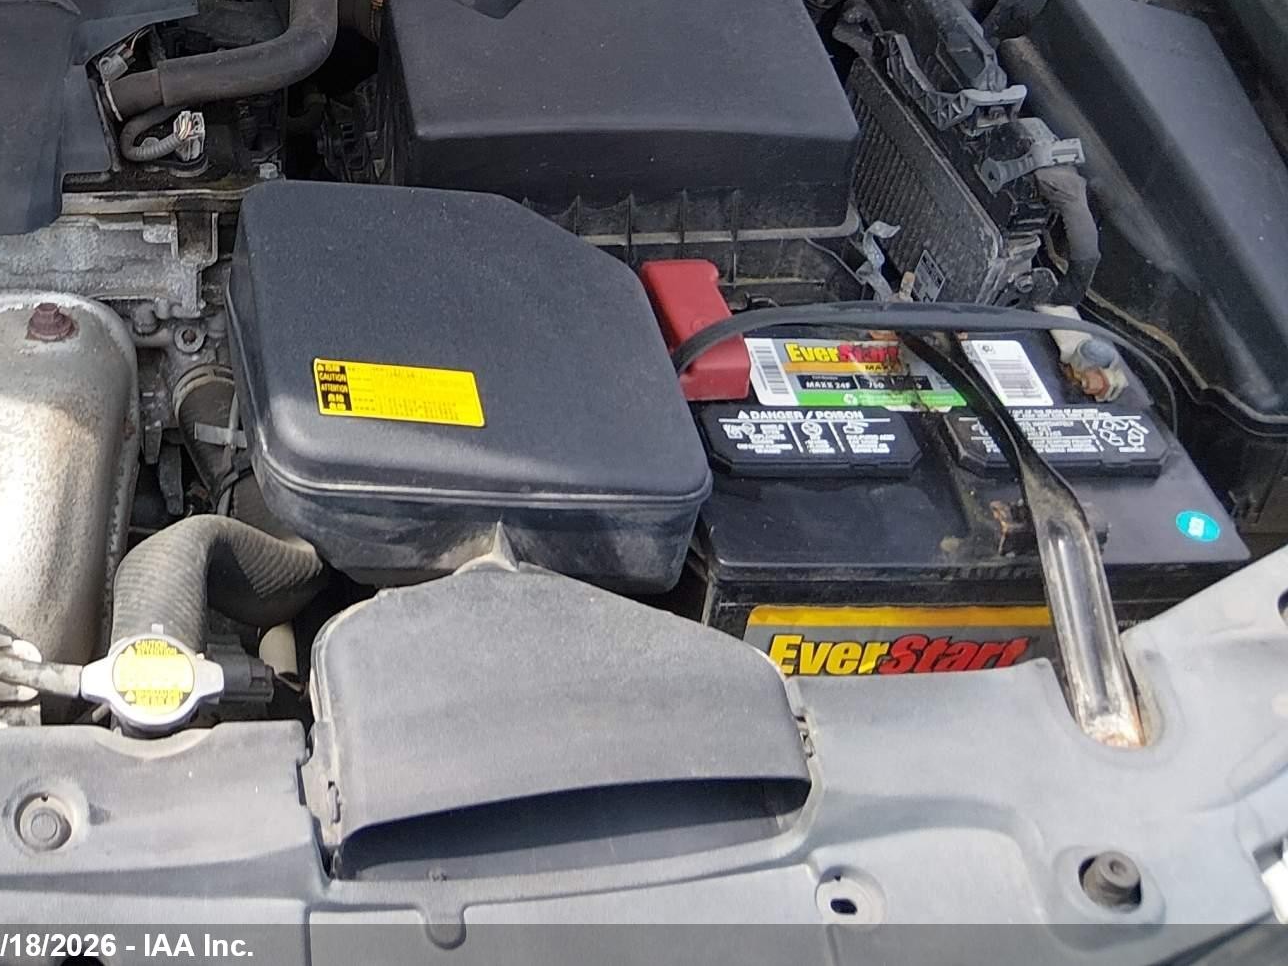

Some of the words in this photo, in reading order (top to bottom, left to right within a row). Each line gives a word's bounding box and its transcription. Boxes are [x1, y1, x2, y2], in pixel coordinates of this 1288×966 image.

[784, 342, 899, 363] EverStart
[318, 372, 347, 382] CAUTION
[750, 410, 804, 420] DANGER
[815, 410, 864, 420] POISON
[769, 634, 1032, 675] EverStart
